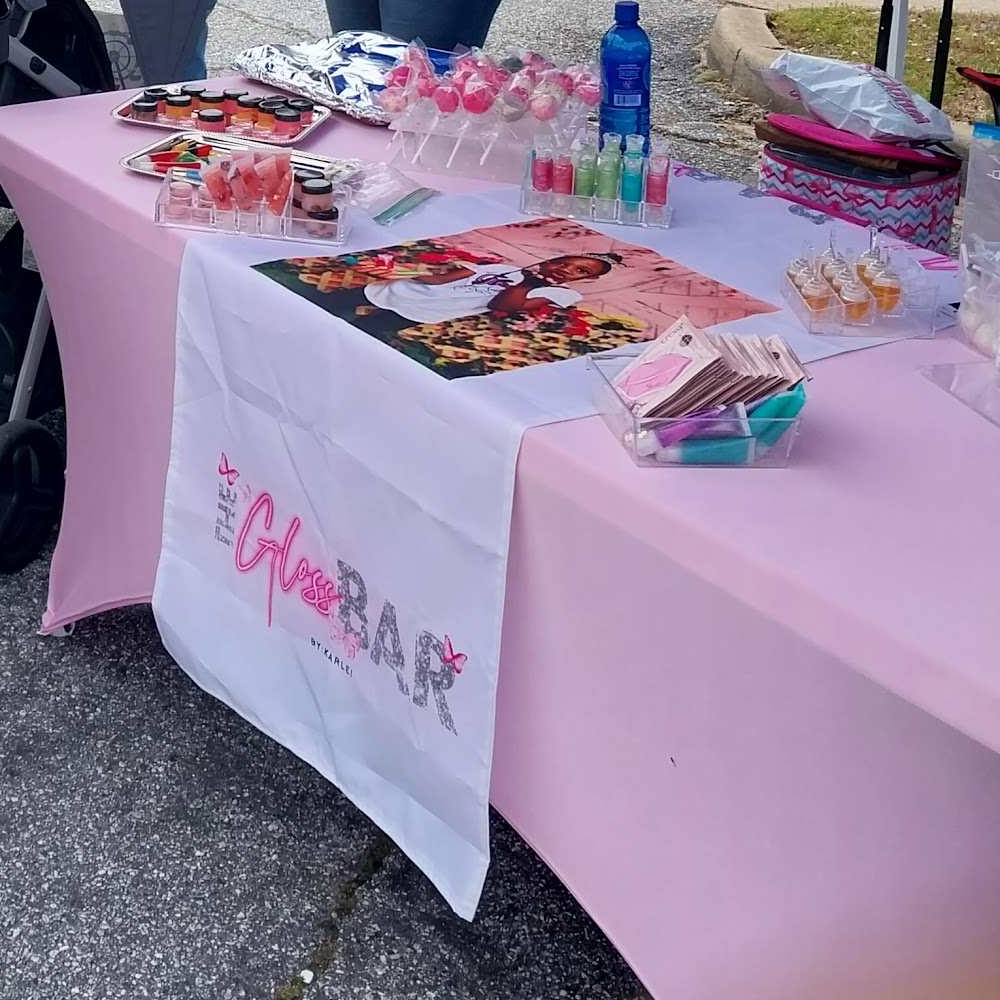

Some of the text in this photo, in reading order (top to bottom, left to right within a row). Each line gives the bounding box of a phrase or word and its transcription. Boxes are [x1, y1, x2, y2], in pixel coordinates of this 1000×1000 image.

[214, 482, 238, 548] THE
[236, 492, 458, 736] Gloss BAR
